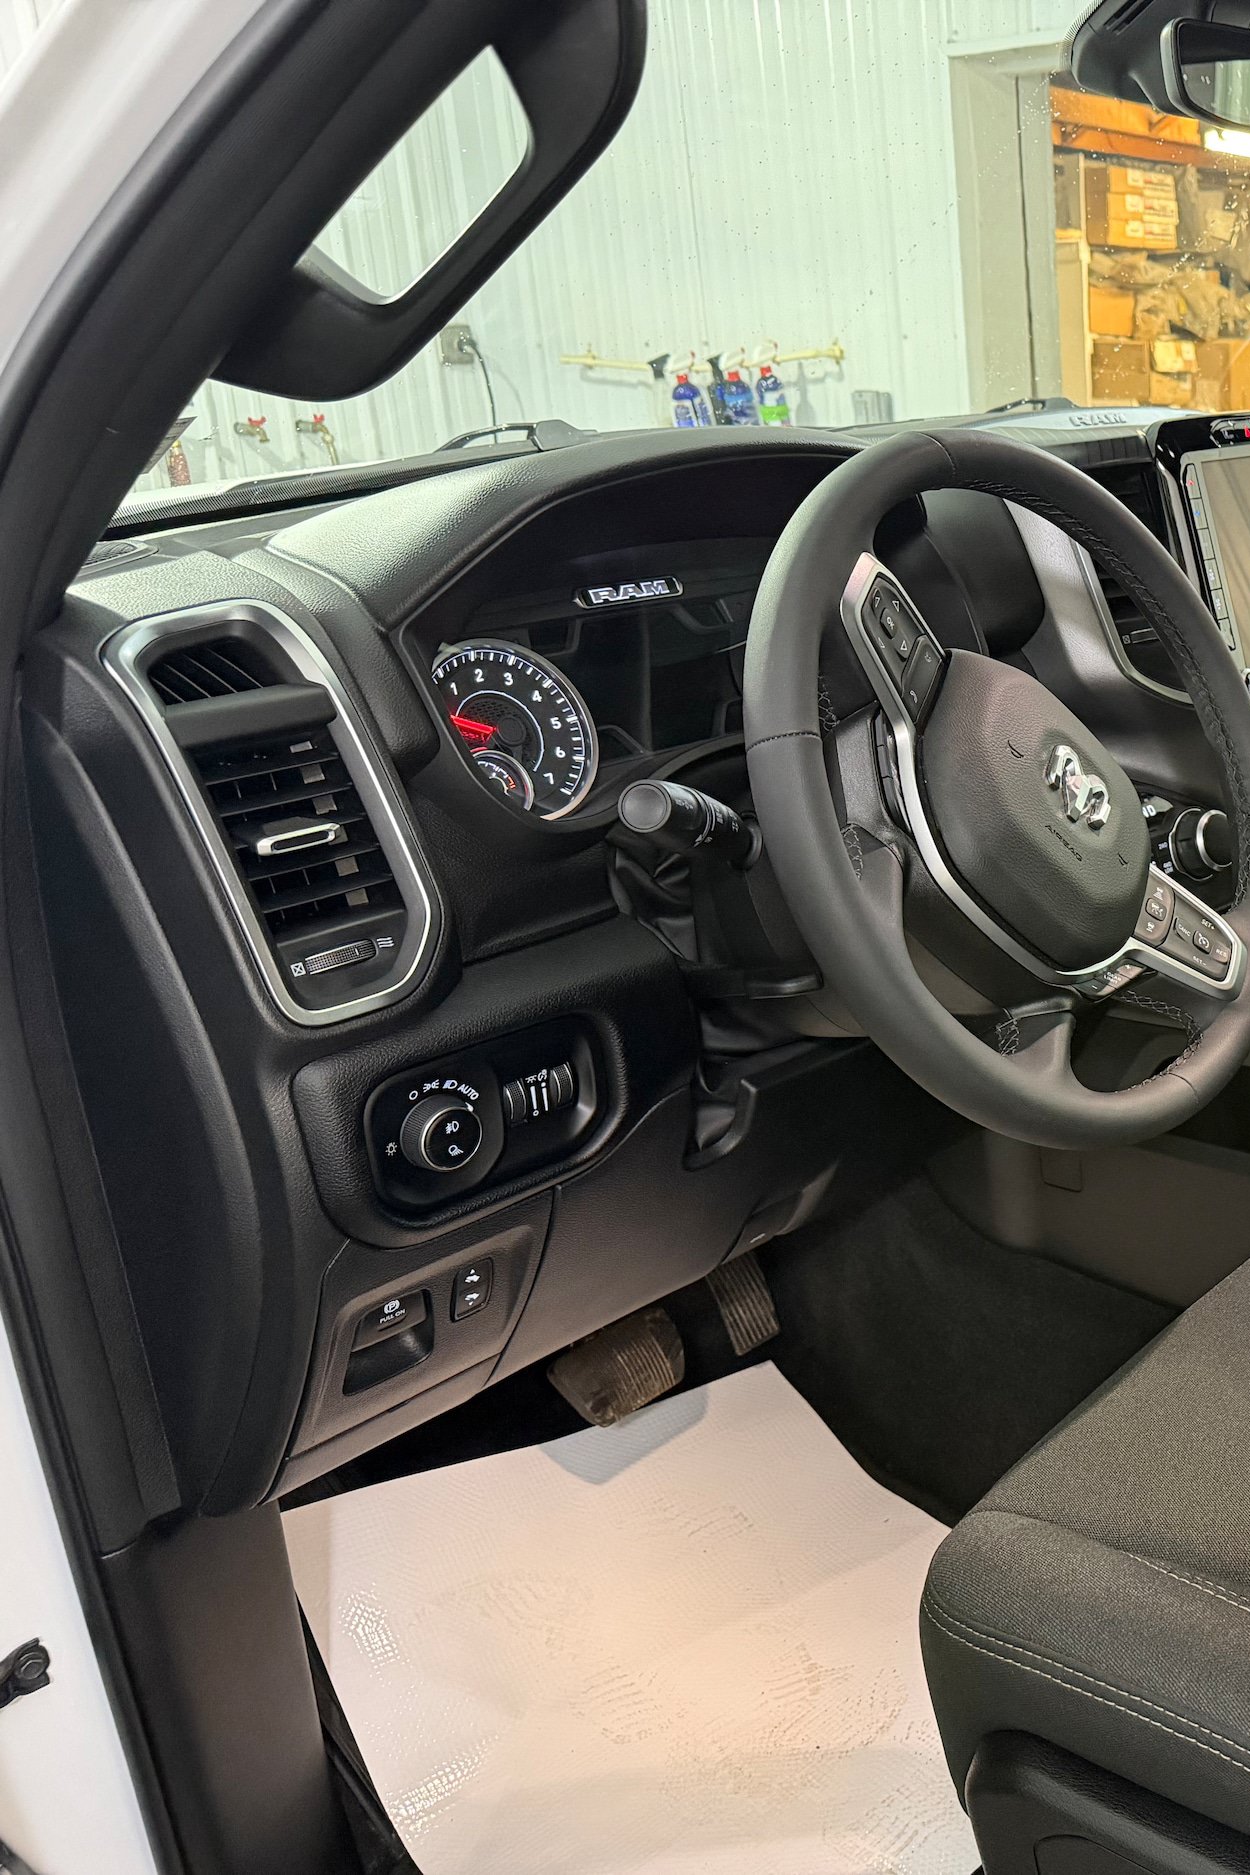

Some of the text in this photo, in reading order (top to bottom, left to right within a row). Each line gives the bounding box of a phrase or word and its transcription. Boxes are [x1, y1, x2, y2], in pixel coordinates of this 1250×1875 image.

[1068, 412, 1127, 428] RAM
[588, 580, 670, 604] RAM
[886, 616, 895, 631] OK
[473, 669, 485, 683] 2
[503, 672, 514, 686] 3
[450, 682, 458, 696] 1
[532, 690, 543, 703] 4
[550, 717, 562, 730] 5
[555, 746, 566, 759] 6
[543, 772, 555, 785] 7
[457, 1083, 480, 1101] AUTO
[379, 1308, 406, 1324] PULL ON
